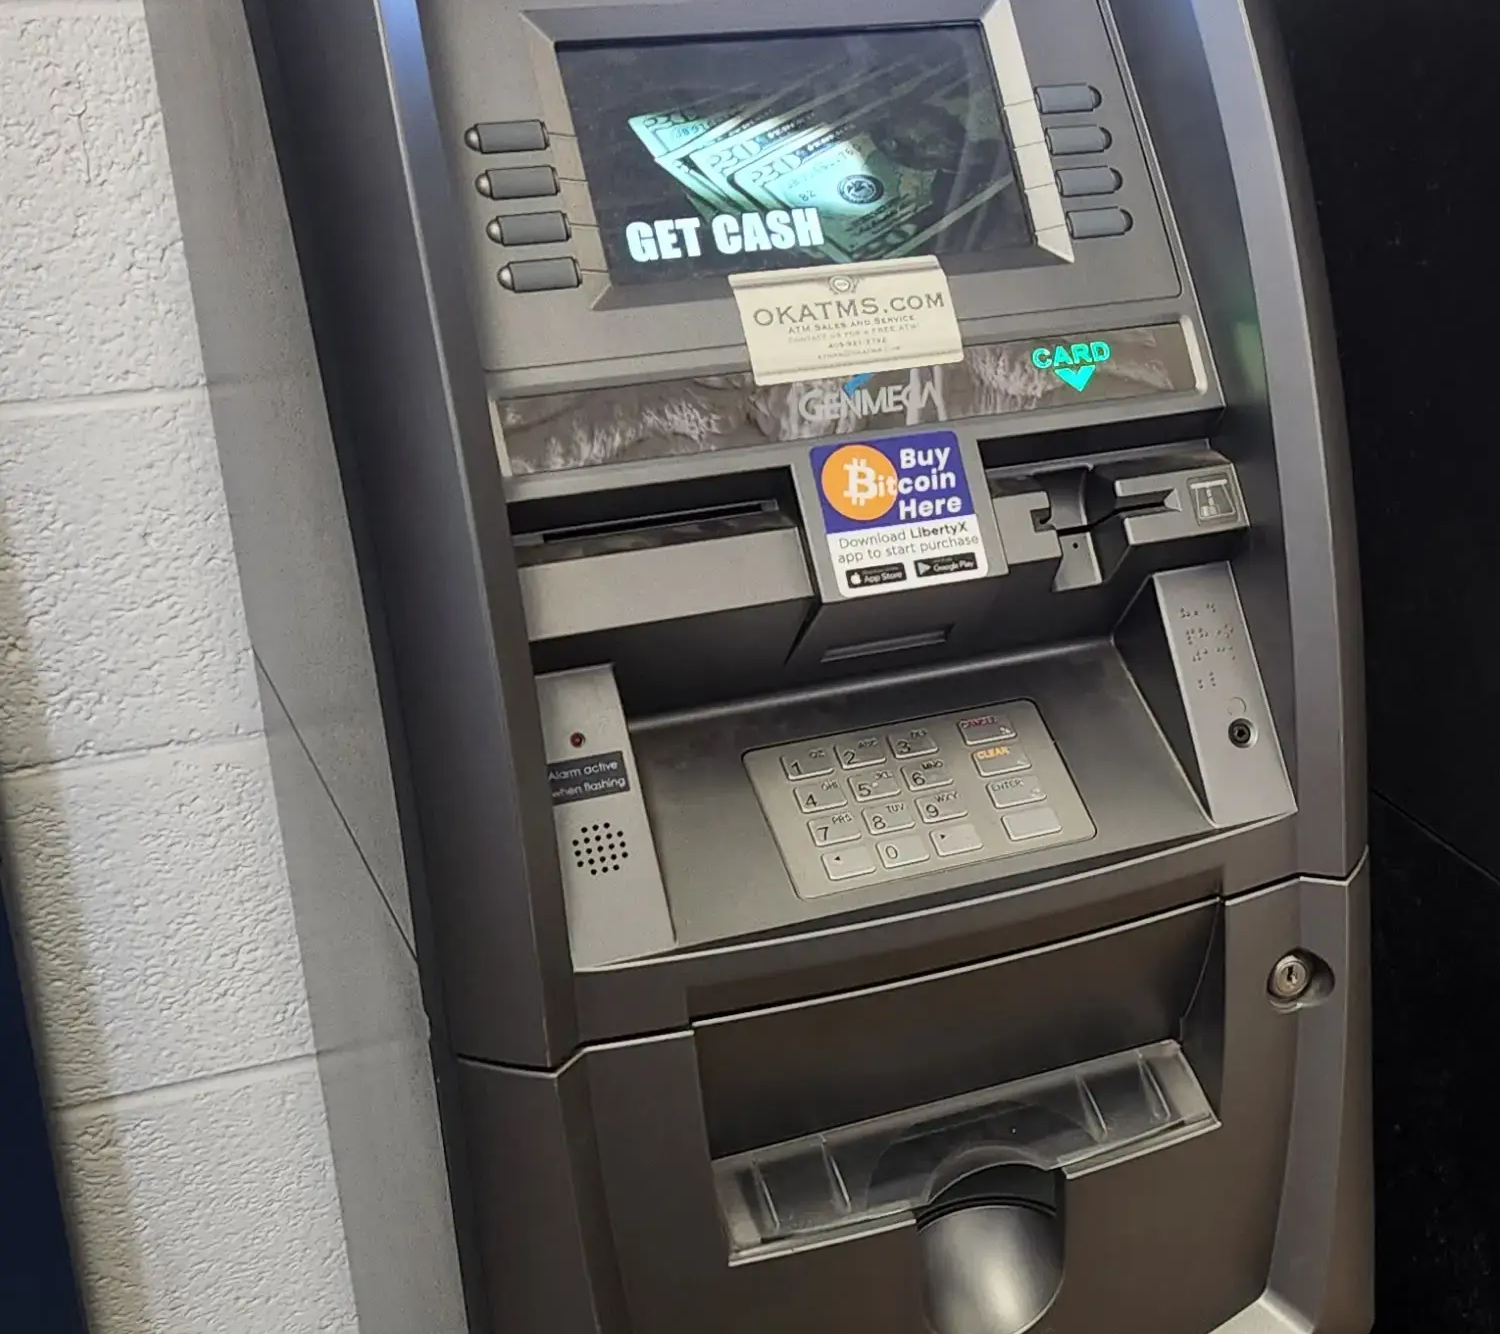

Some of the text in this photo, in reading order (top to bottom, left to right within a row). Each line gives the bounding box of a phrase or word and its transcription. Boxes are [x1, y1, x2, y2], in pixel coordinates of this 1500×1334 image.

[625, 207, 825, 263] GET CASH
[753, 291, 945, 327] OKATMS.COM
[788, 325, 811, 334] ATM
[1032, 341, 1110, 369] CARD
[900, 446, 951, 471] Buy
[843, 457, 956, 506] Bitcoin
[899, 496, 962, 520] Here
[838, 521, 968, 549] Download LibertyX
[838, 534, 979, 564] app to start purchase
[933, 562, 958, 572] Google
[960, 559, 975, 570] Play
[864, 573, 880, 584] App
[881, 570, 903, 581] Store
[898, 739, 911, 754] 3
[976, 746, 1011, 759] CLEAR
[843, 750, 856, 766] 2
[548, 760, 618, 781] Alarm active
[790, 761, 801, 775] 1
[583, 777, 626, 792] flashing
[911, 772, 925, 786] 6
[991, 778, 1024, 792] ENTER
[858, 782, 871, 797] 5
[805, 794, 817, 808] 4
[925, 803, 939, 818] 9
[872, 815, 886, 829] 8
[816, 826, 829, 841] 7
[885, 845, 898, 859] 0
